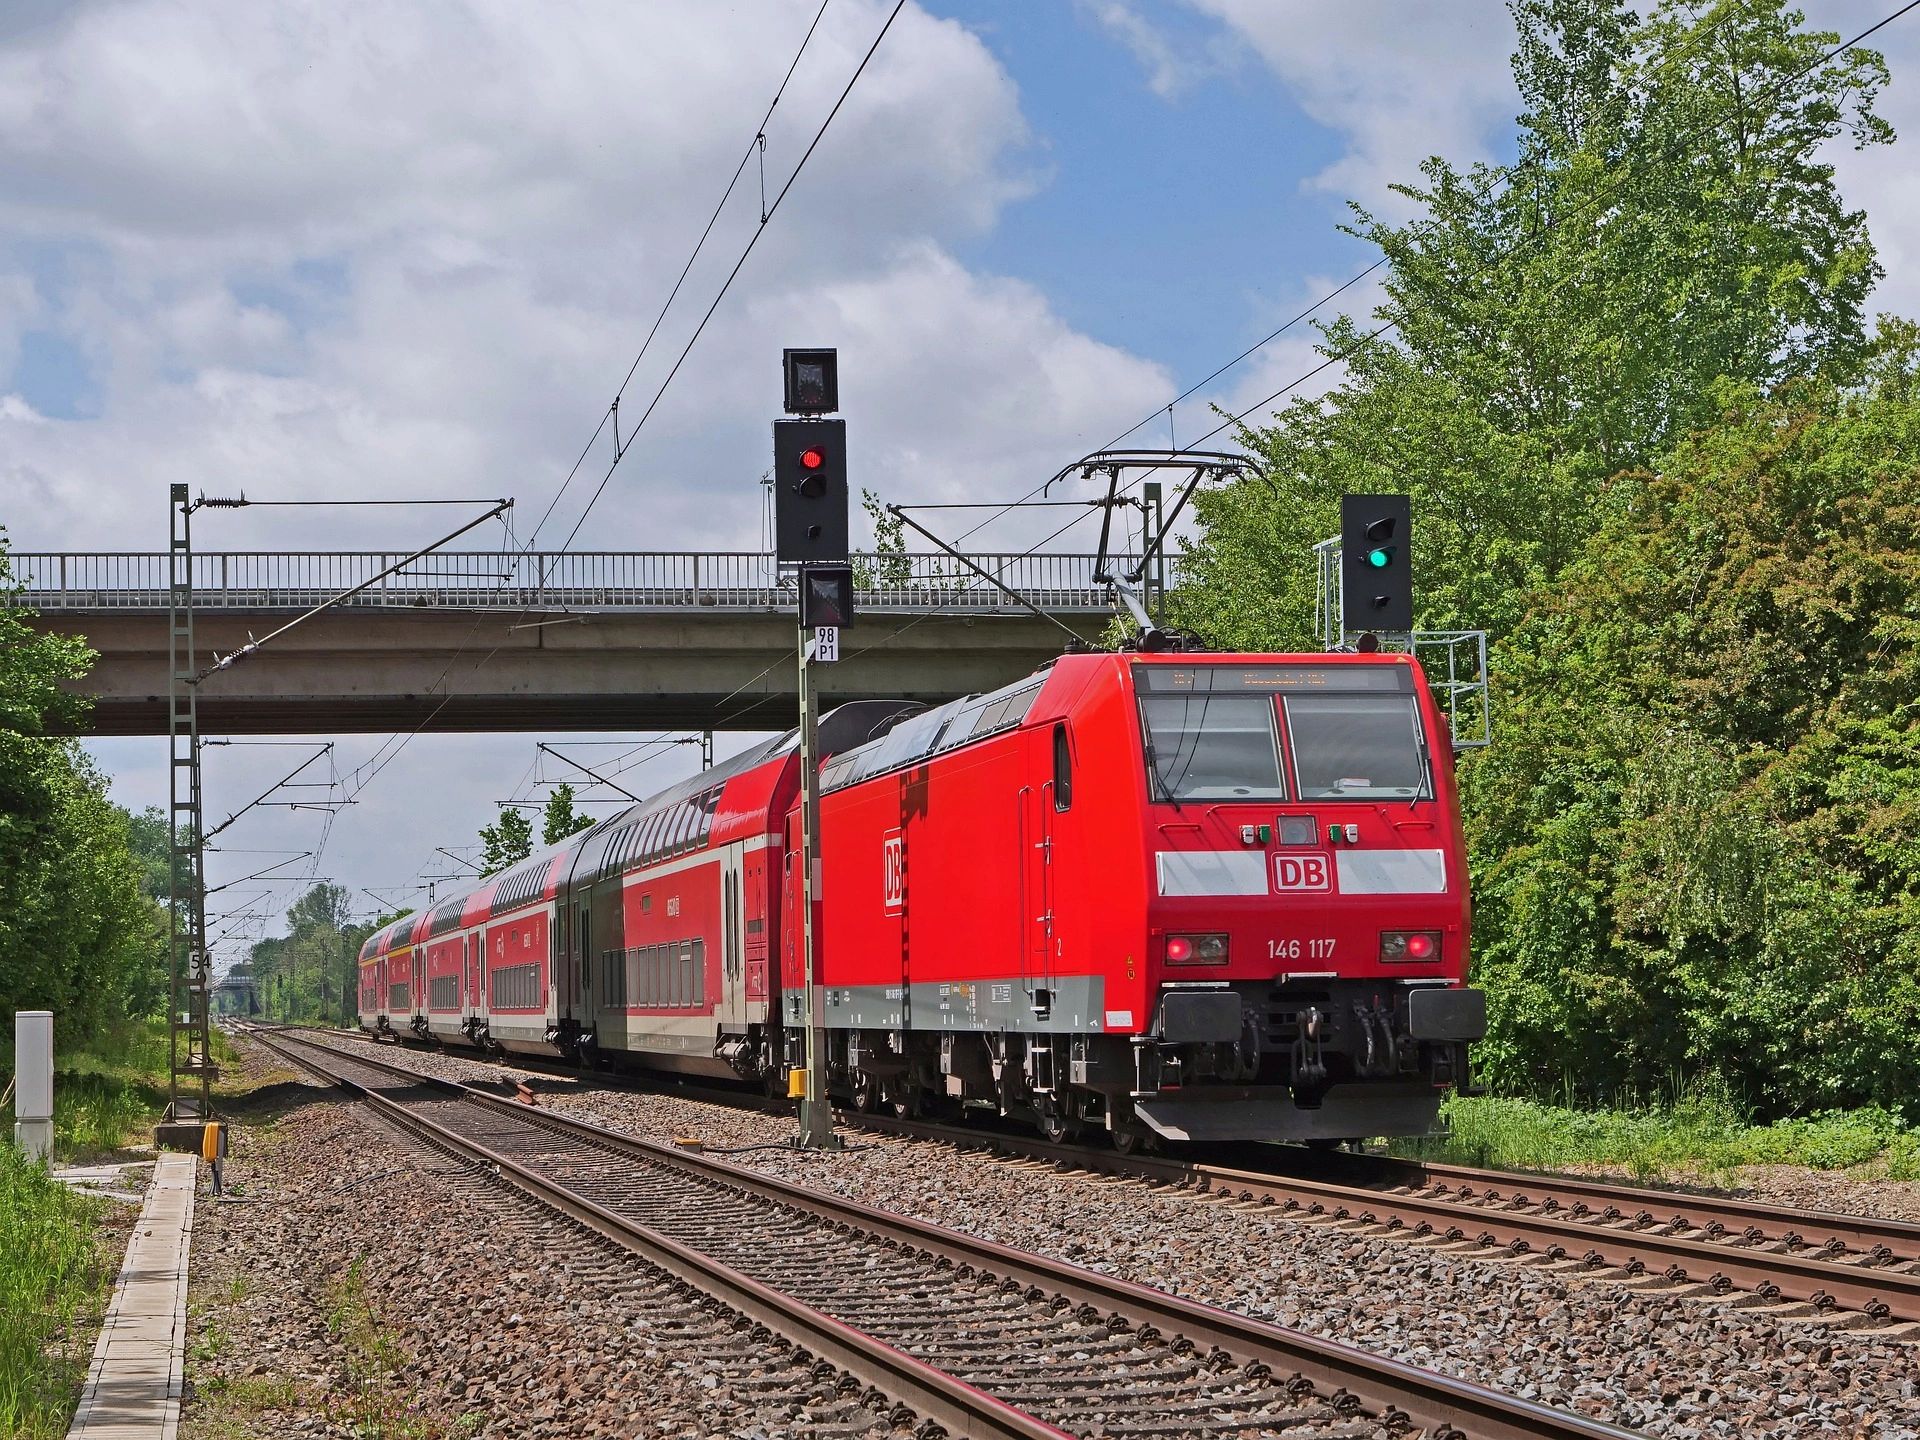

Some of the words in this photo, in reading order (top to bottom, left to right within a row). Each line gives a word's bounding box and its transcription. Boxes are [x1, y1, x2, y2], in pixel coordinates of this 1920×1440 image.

[819, 627, 834, 643] 98
[820, 644, 834, 660] P1
[886, 843, 902, 901] DB
[1280, 859, 1325, 887] DB
[1267, 939, 1301, 959] 146
[1309, 939, 1337, 958] 117
[191, 954, 211, 969] 54
